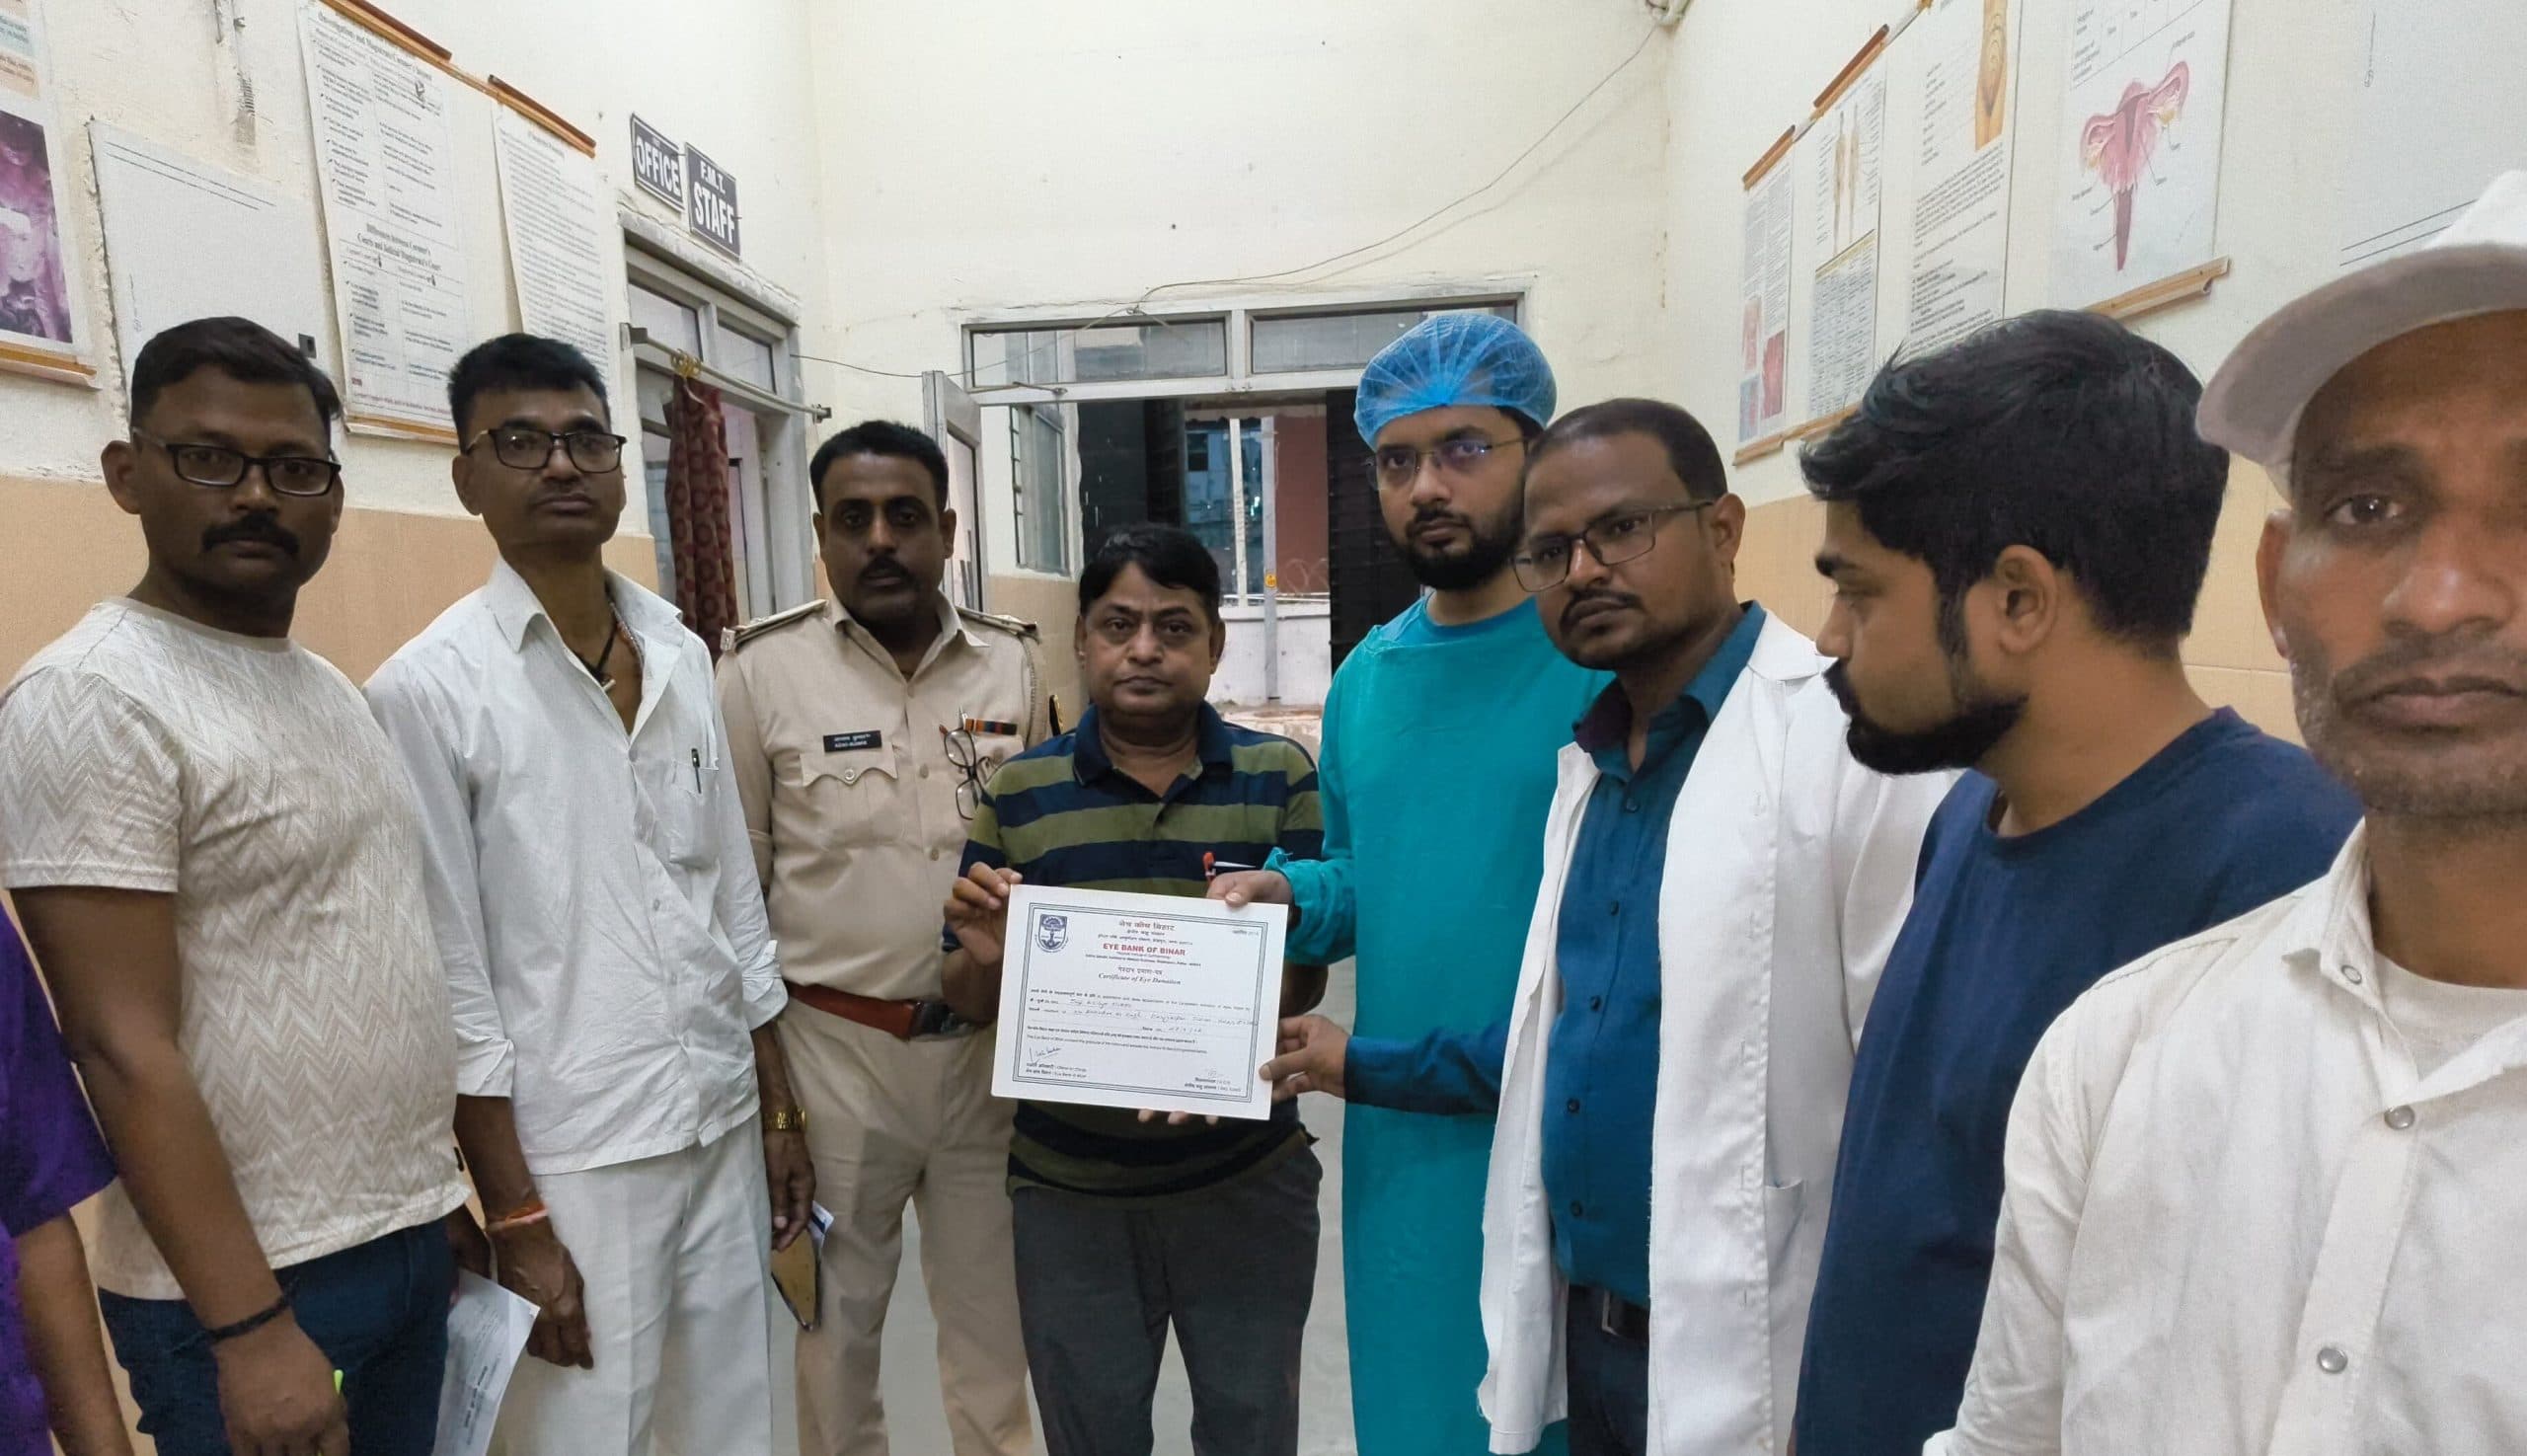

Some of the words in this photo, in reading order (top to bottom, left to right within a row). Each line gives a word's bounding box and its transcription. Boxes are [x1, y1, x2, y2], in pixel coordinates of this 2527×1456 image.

[636, 135, 682, 197] OFFICE
[693, 181, 735, 245] STAFF
[1121, 944, 1144, 953] BANK
[1098, 972, 1130, 981] Certificate
